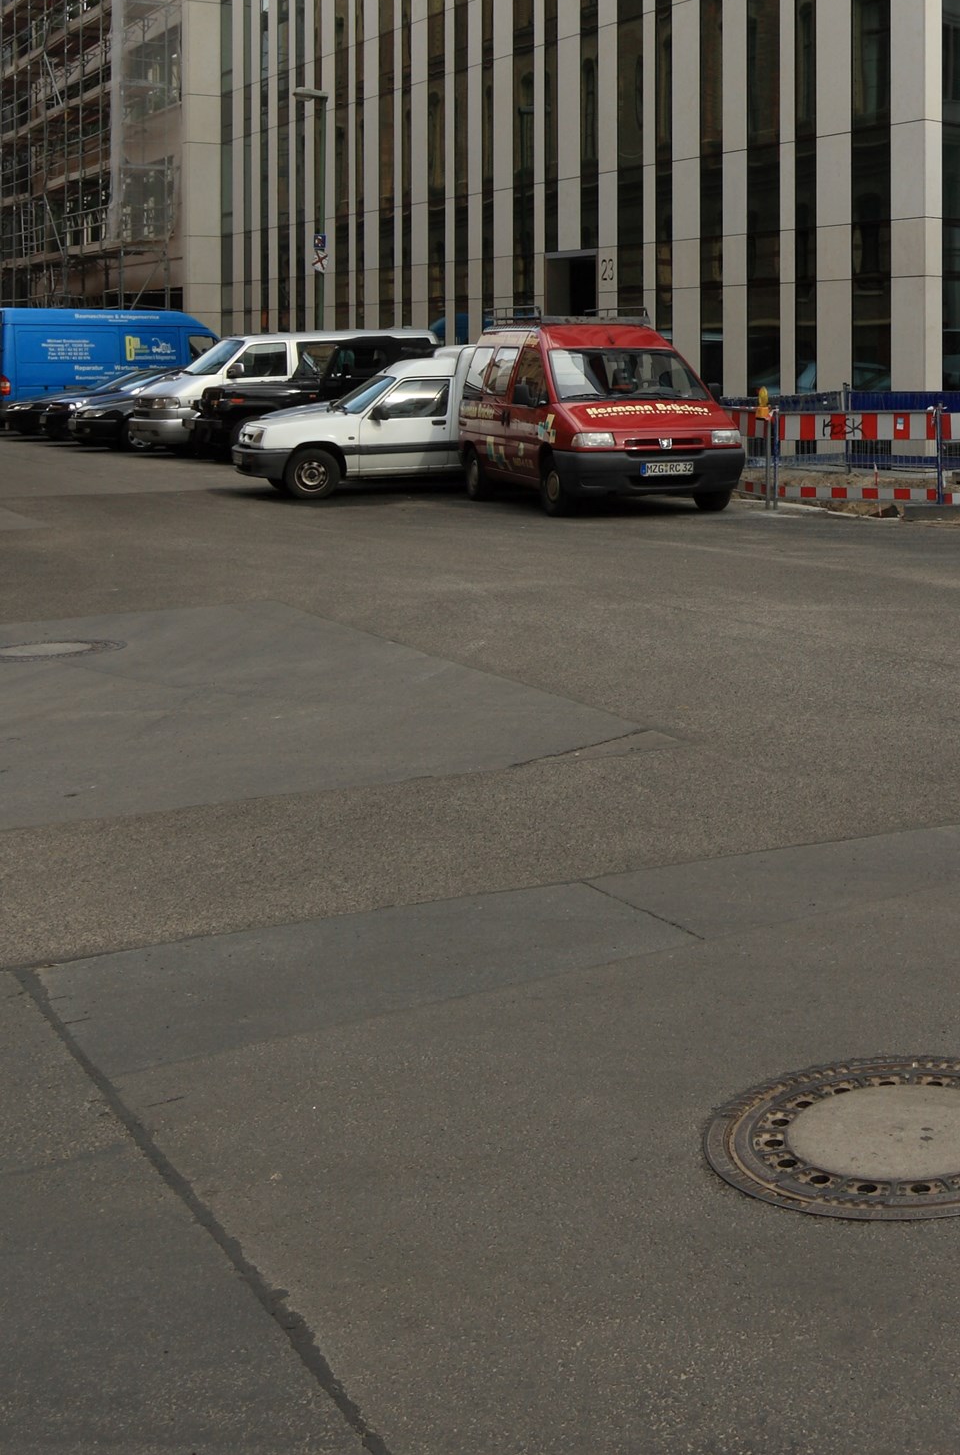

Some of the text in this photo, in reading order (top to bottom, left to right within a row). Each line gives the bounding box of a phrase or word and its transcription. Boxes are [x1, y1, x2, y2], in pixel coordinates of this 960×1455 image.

[600, 258, 614, 281] 23
[586, 403, 709, 415] Hermann Brücker
[646, 464, 664, 474] MZG
[682, 463, 693, 473] 32
